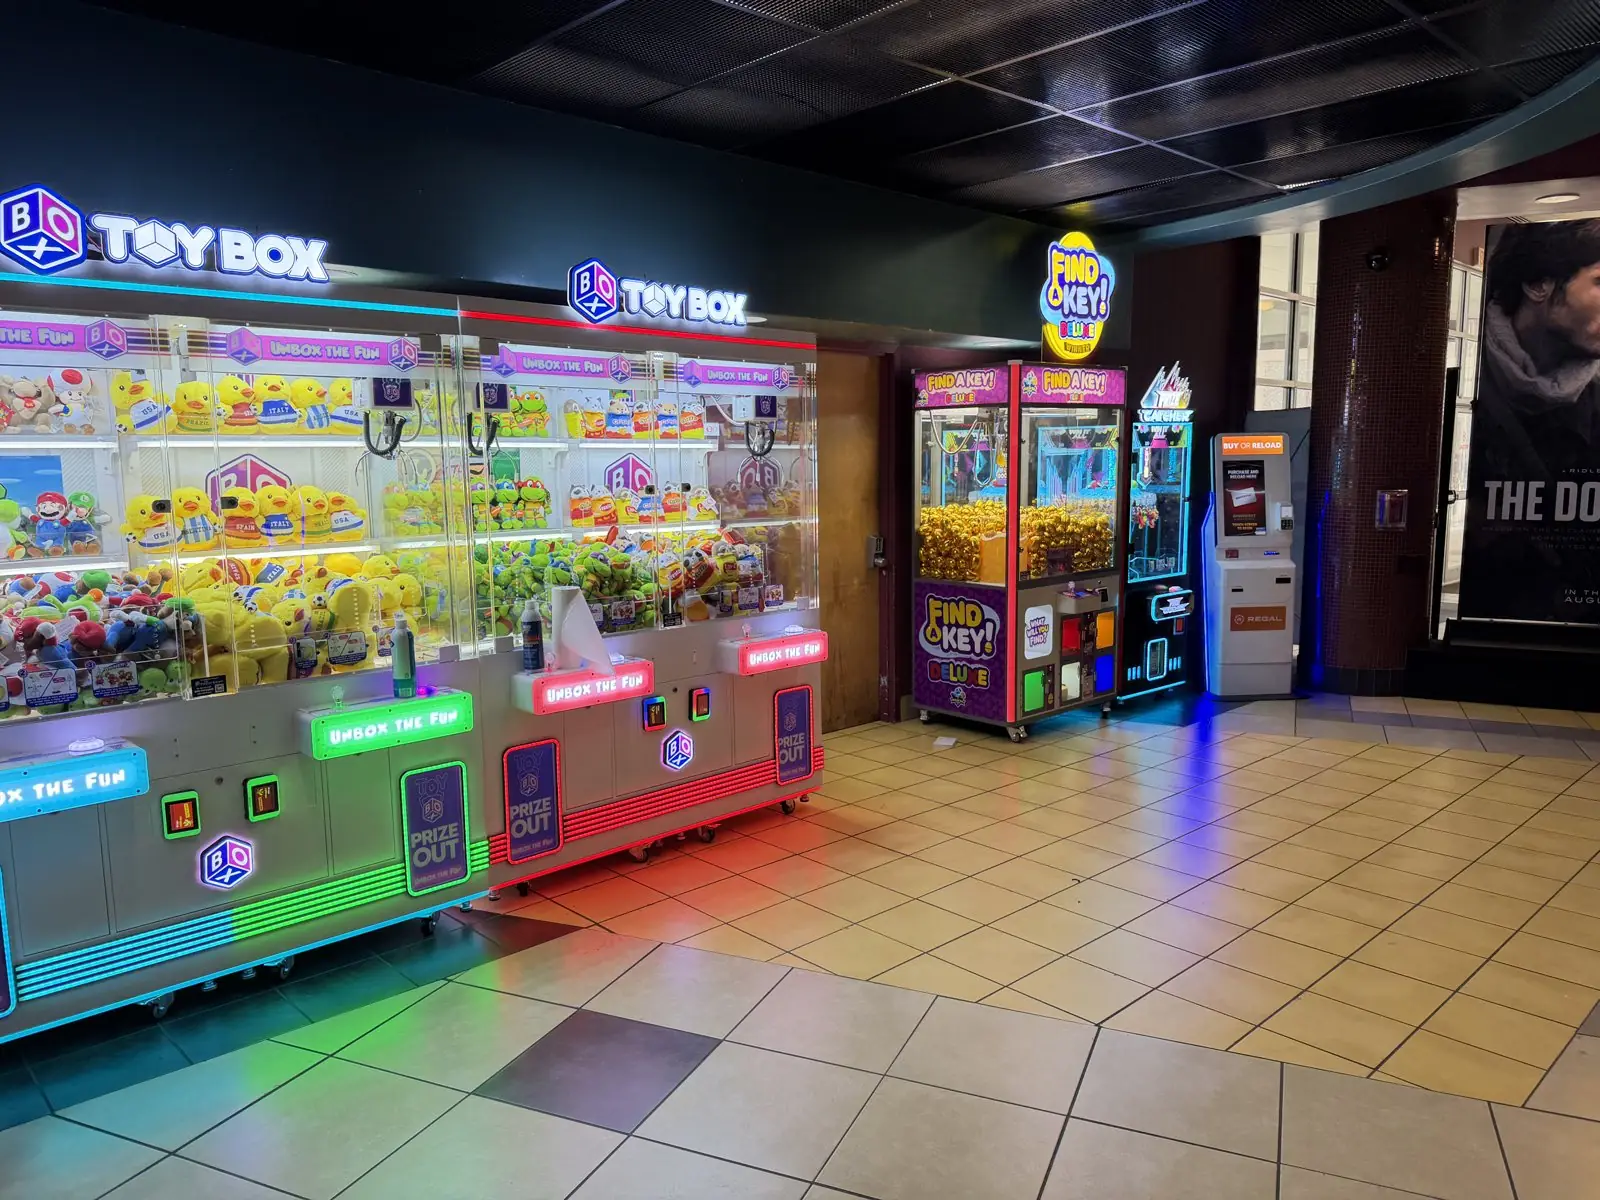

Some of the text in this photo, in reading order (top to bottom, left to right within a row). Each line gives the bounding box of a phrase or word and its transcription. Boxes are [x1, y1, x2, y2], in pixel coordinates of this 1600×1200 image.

[217, 228, 330, 283] BOX
[1051, 249, 1100, 285] FIND
[686, 287, 748, 326] BOX
[1063, 278, 1109, 317] KEY!
[38, 327, 75, 346] FUN
[1060, 321, 1096, 338] DELUXE
[270, 341, 322, 357] UNBOX
[324, 345, 351, 359] THE
[354, 345, 381, 361] FUN
[522, 357, 561, 371] UNBOX
[563, 361, 581, 372] THE
[584, 361, 603, 374] FUN
[707, 370, 736, 381] UNBOX
[738, 372, 751, 382] THE
[753, 372, 768, 383] FUN
[928, 370, 995, 391] FIND A KEY!
[1043, 370, 1106, 392] FIND A KEY!
[141, 403, 158, 416] USA
[268, 406, 290, 415] ITALY
[344, 409, 359, 417] USA
[1223, 442, 1239, 450] BUY
[1252, 441, 1282, 449] RELOAD
[1484, 480, 1600, 523] THE DO
[235, 523, 256, 532] SPAIN
[270, 518, 291, 528] ITALY
[334, 516, 350, 525] USA
[928, 598, 982, 628] FIND
[1029, 616, 1046, 628] WHAT
[942, 621, 994, 654] KEY!
[1026, 624, 1049, 638] WILL YOU
[1029, 635, 1048, 648] FIND?
[749, 643, 820, 666] UNBOX THE FUN
[929, 660, 989, 687] DELUXE
[546, 674, 643, 703] UNBOX THE FUN
[329, 710, 458, 745] UNBOX THE FUN
[778, 732, 805, 749] PRIZE
[779, 744, 805, 765] OUT
[32, 779, 75, 799] THE
[84, 769, 126, 790] FUN
[510, 796, 552, 820] PRIZE
[411, 822, 459, 849] PRIZE
[511, 812, 552, 839] OUT
[412, 838, 460, 868] OUT
